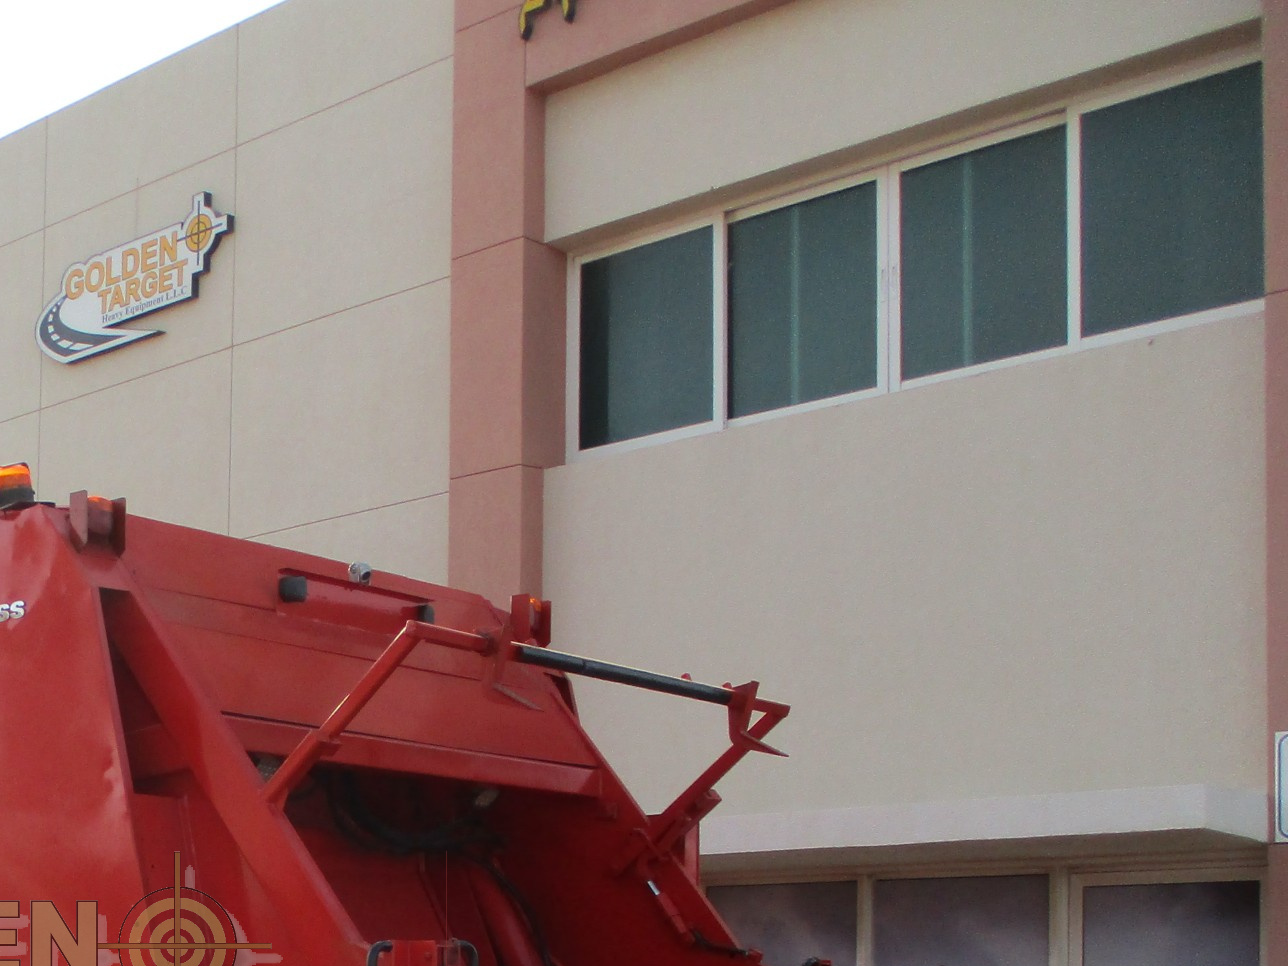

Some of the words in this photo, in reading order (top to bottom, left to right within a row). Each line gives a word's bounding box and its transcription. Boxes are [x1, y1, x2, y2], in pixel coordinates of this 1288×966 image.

[65, 231, 178, 300] GOLDEN
[98, 258, 188, 315] TARGET
[125, 293, 165, 316] Equipment
